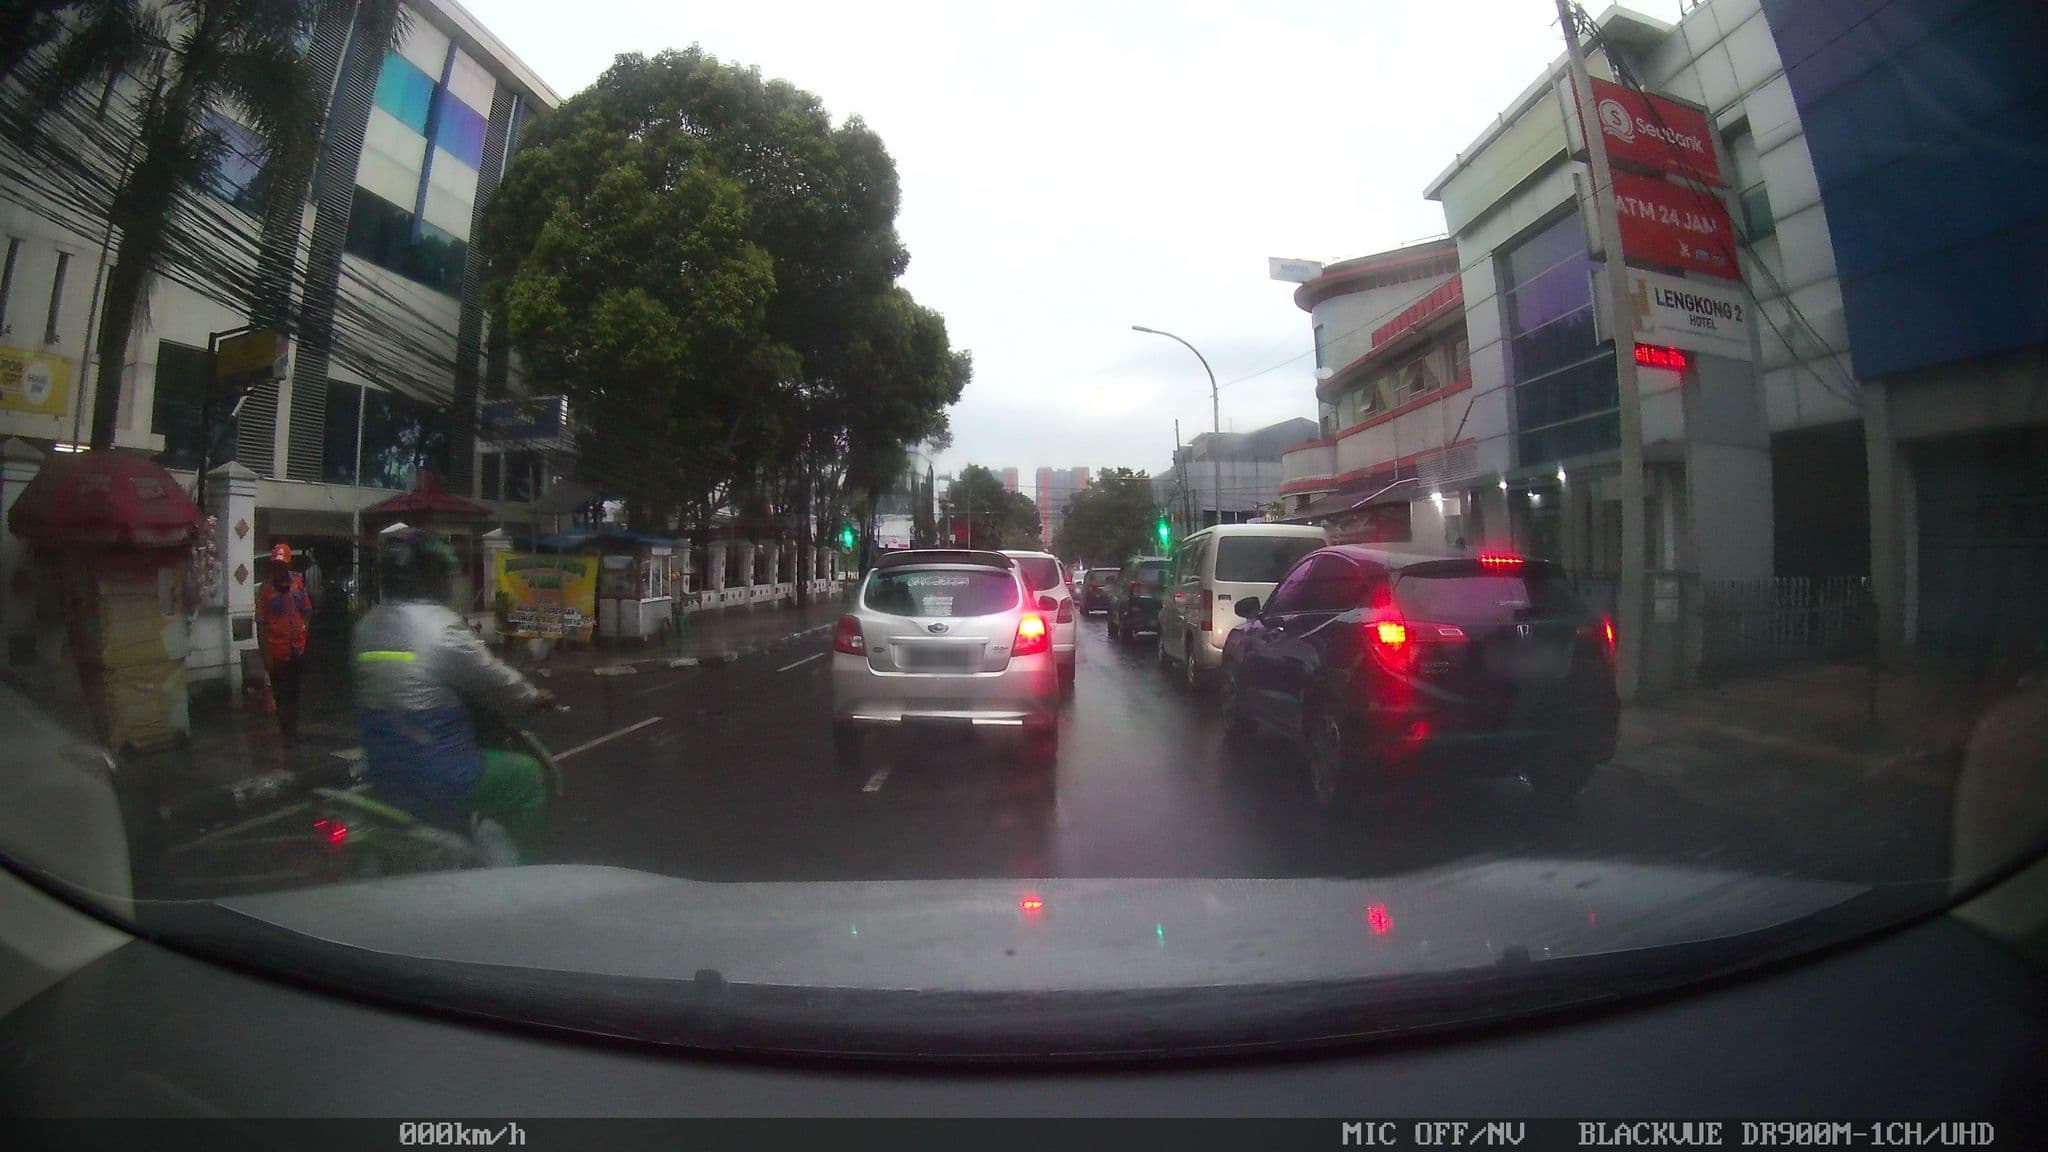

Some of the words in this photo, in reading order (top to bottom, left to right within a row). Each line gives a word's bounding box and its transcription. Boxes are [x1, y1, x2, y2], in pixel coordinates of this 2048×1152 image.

[1616, 195, 1656, 221] ATM
[1659, 205, 1680, 227] 24
[1654, 287, 1733, 320] LENGKONG
[1734, 304, 1743, 322] 2
[1689, 314, 1718, 329] HOTEL
